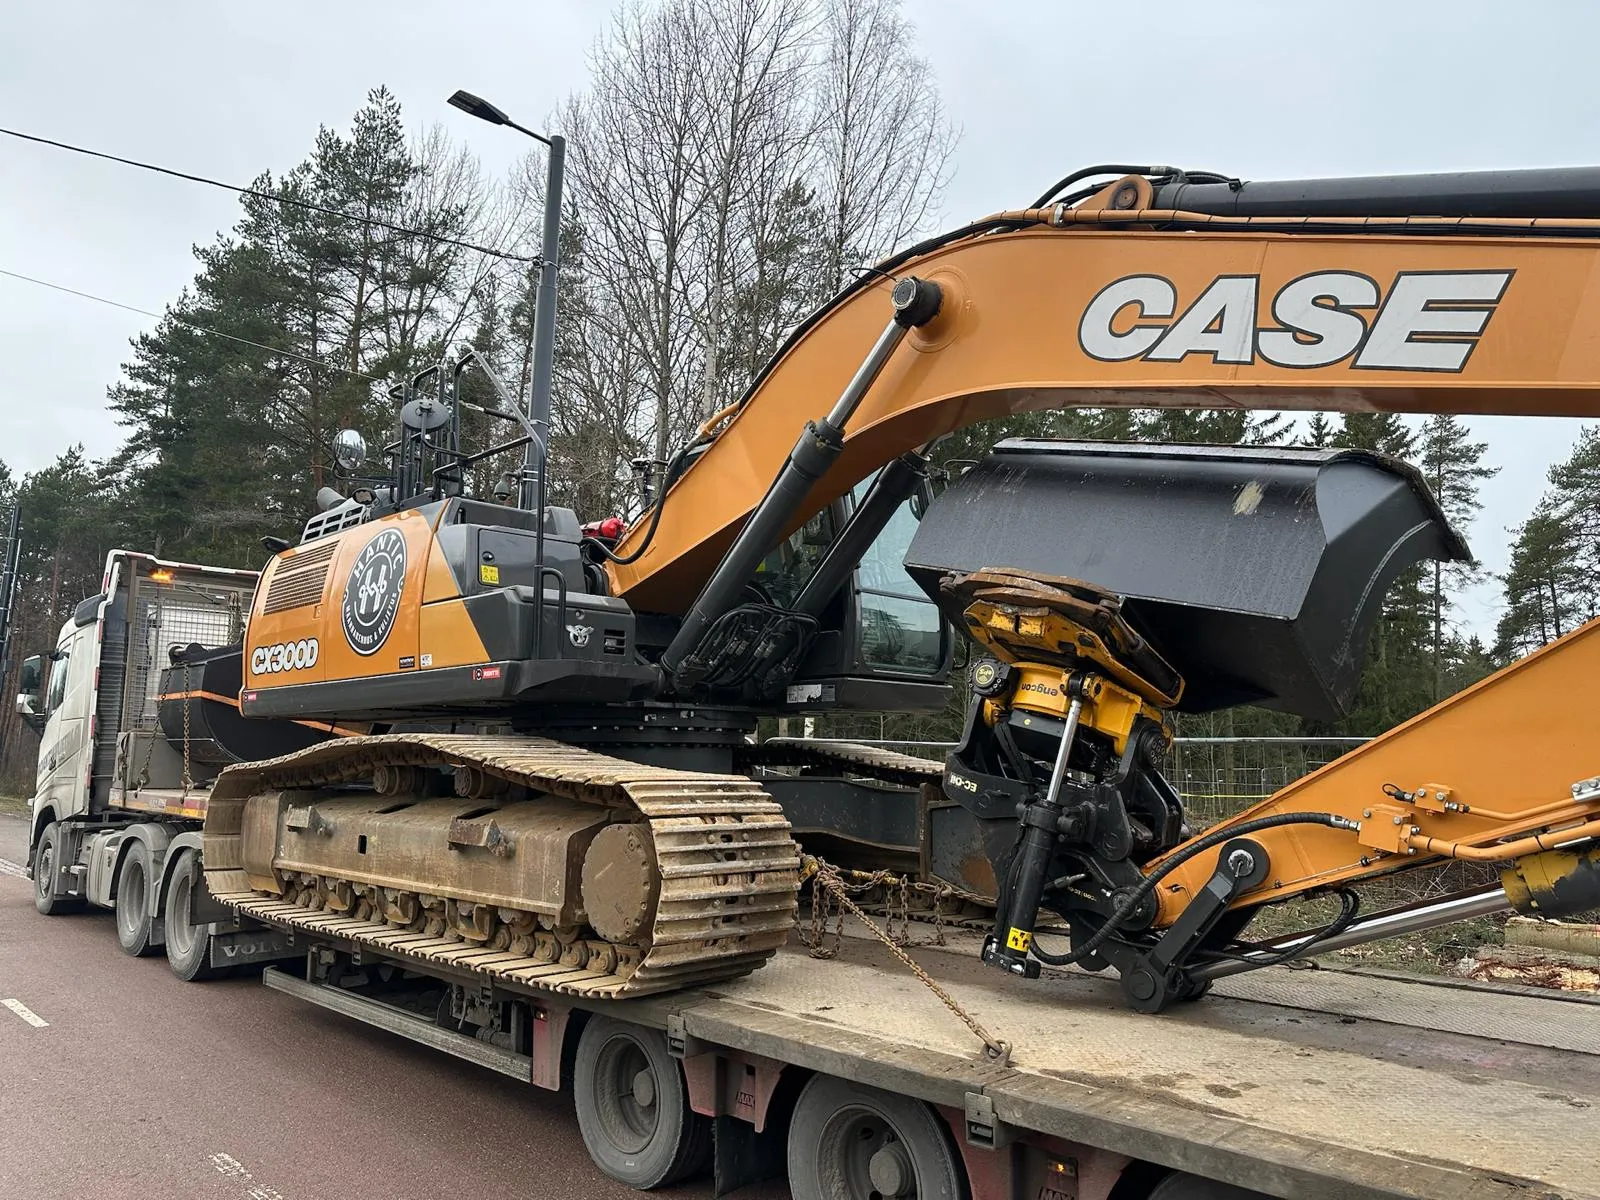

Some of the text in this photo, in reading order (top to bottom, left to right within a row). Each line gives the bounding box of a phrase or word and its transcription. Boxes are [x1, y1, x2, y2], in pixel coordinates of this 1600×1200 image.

[1078, 269, 1517, 373] CASE
[353, 533, 403, 579] HANTIC
[251, 637, 319, 676] CX300D
[1021, 683, 1058, 697] engcon
[220, 941, 283, 958] VOLV
